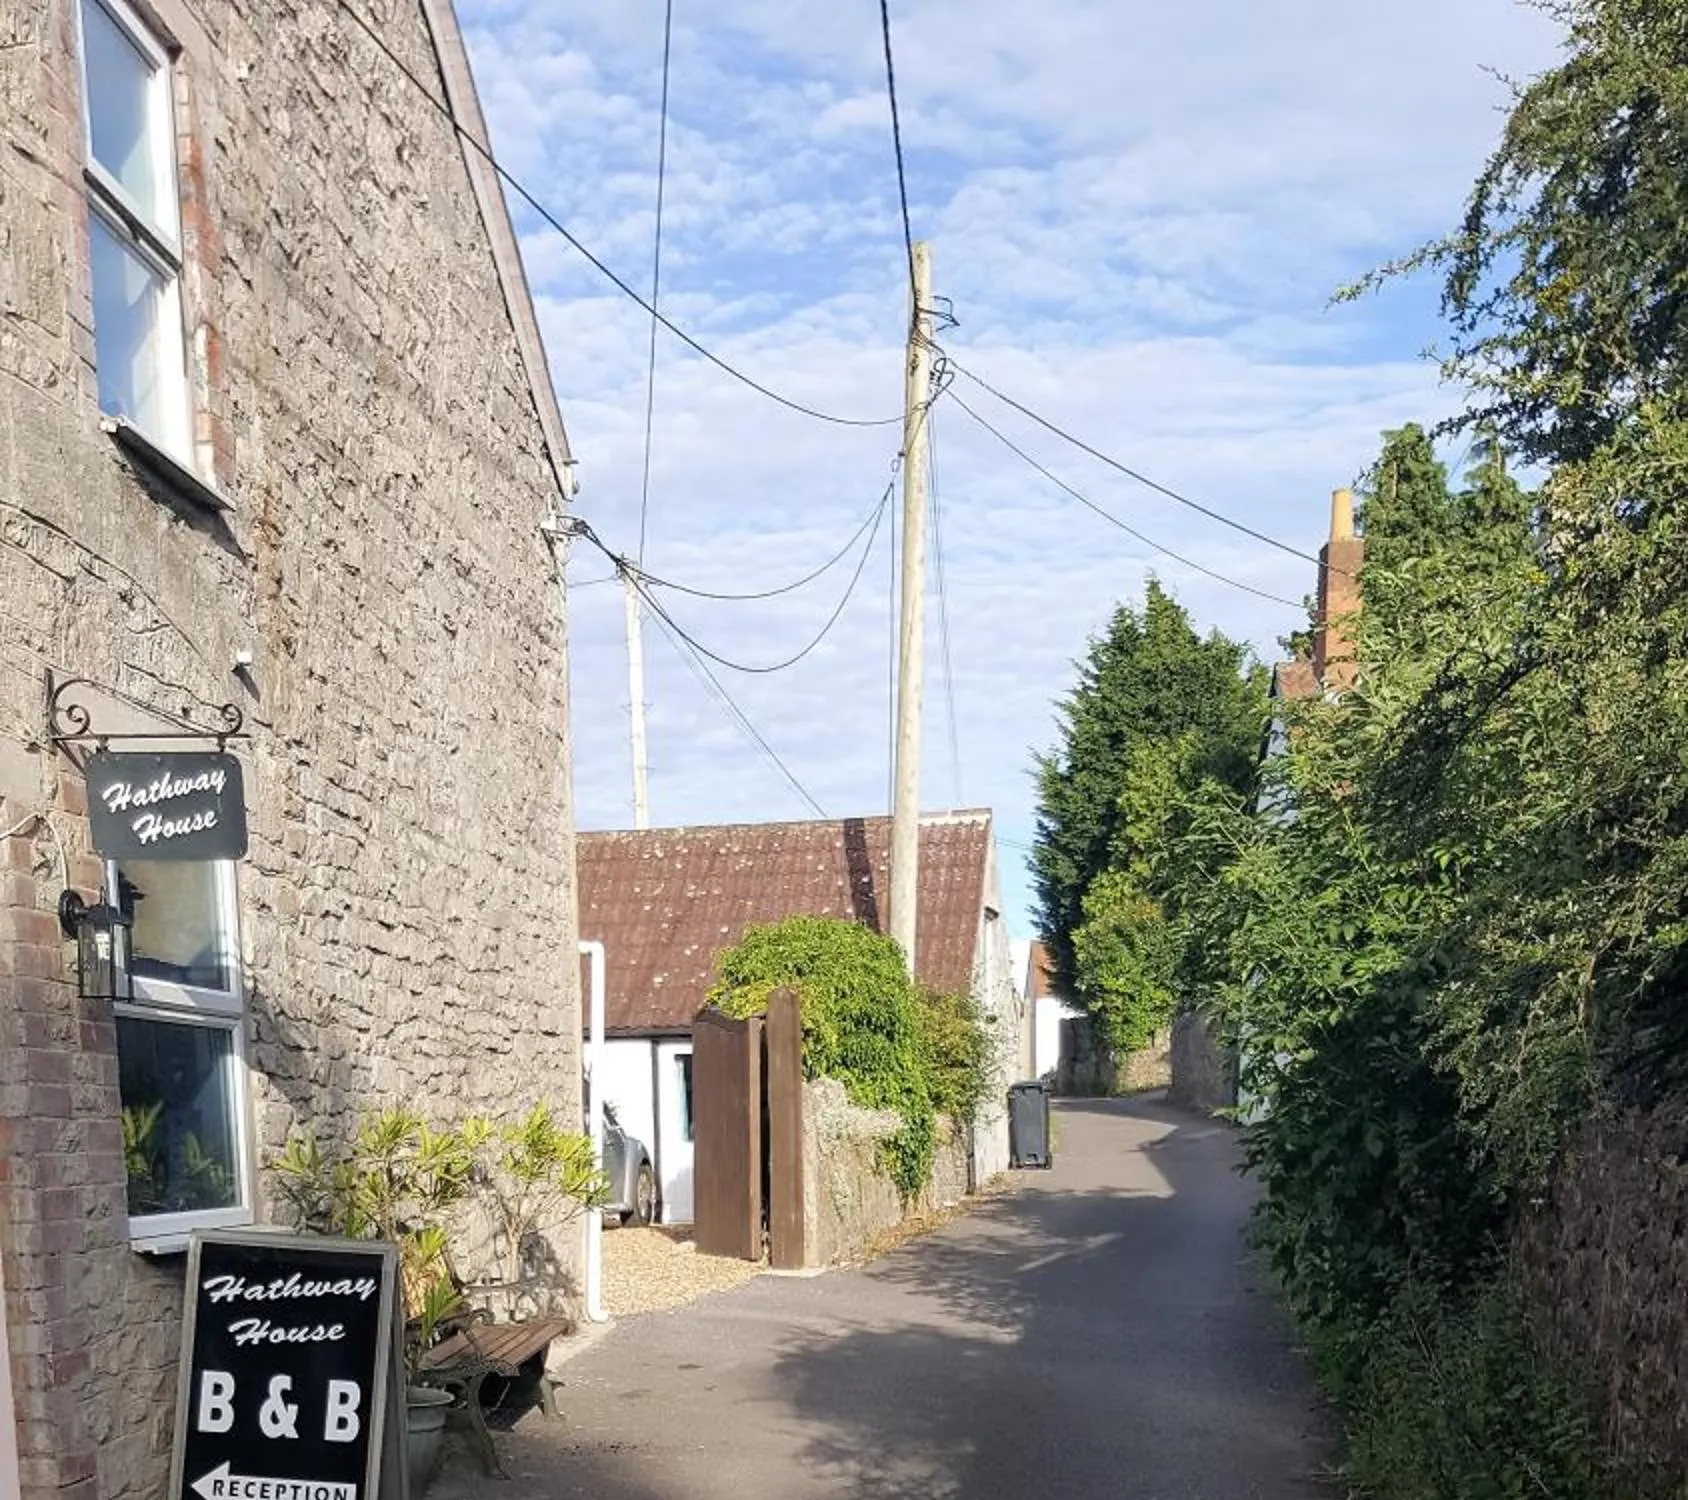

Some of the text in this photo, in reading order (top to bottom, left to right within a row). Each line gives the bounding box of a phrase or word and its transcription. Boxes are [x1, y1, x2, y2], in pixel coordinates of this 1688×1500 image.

[102, 769, 227, 812] Hathway
[131, 809, 219, 845] House
[203, 1272, 377, 1303] Hathway
[228, 1317, 346, 1346] House
[198, 1369, 361, 1443] B & B
